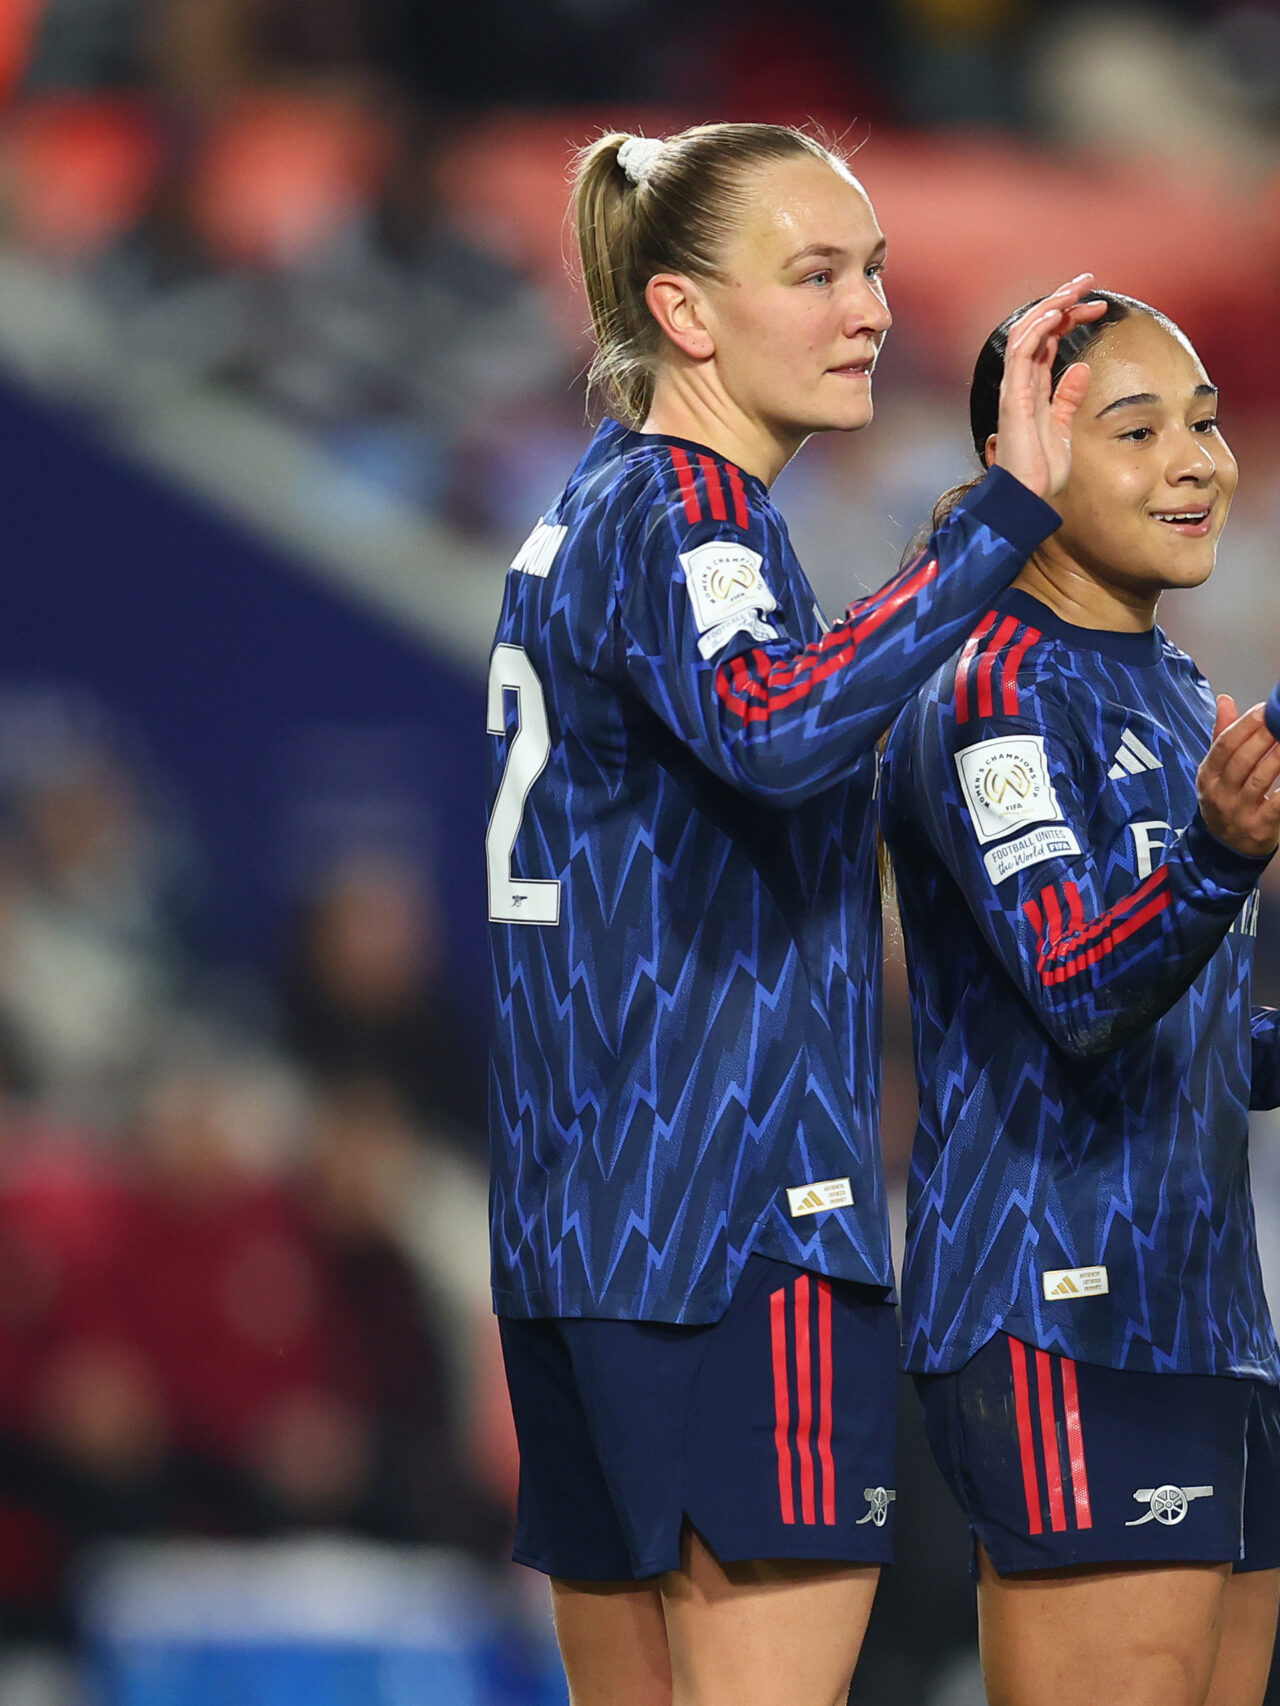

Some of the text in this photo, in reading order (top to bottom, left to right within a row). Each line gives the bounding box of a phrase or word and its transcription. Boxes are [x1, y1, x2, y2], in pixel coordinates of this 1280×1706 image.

[985, 753, 1037, 780] CHAMPIONS
[1005, 803, 1023, 812] FIFA
[991, 829, 1067, 864] FOOTBALL UNITES
[997, 860, 1014, 876] the
[1013, 843, 1046, 867] World
